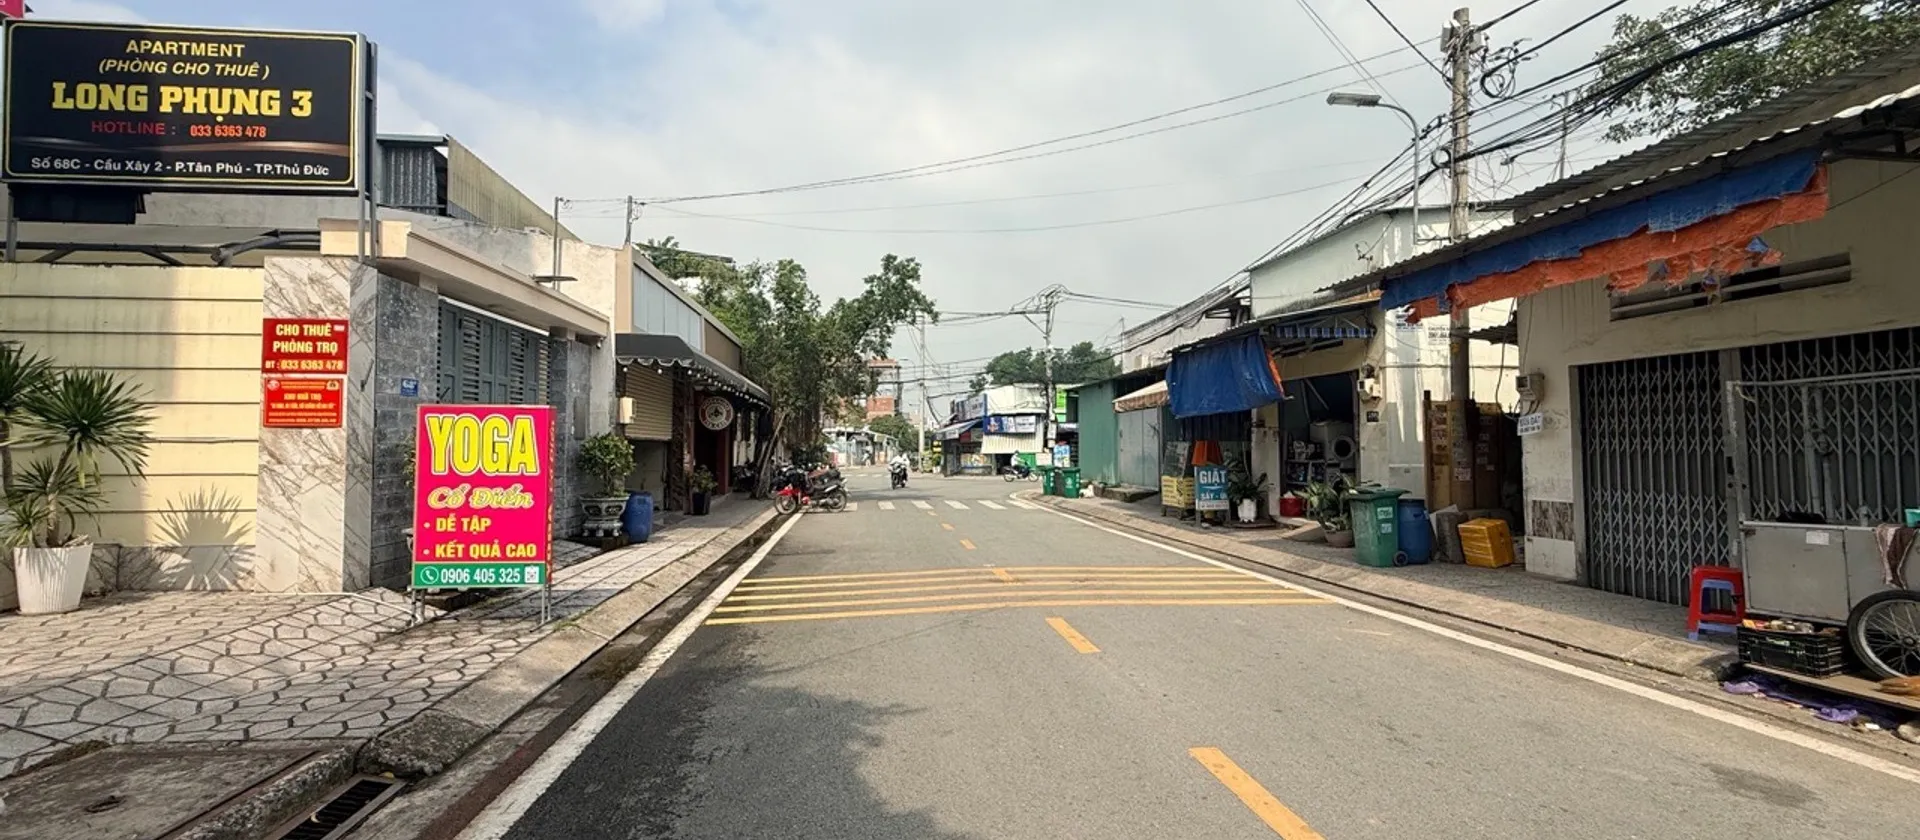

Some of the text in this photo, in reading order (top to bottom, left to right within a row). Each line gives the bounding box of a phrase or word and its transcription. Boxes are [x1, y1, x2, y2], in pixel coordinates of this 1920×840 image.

[126, 39, 244, 58] APARTMENT
[98, 57, 168, 74] (PHÒNG
[172, 61, 210, 76] CHO
[215, 61, 260, 77] THUÊ
[52, 82, 313, 122] LONG PHỤNG 3
[91, 121, 166, 135] HOTLINE
[190, 125, 212, 137] 033
[214, 125, 243, 138] 6363
[245, 126, 267, 138] 478
[31, 156, 51, 169] Số
[53, 158, 81, 169] 68C
[125, 160, 149, 173] Xây
[154, 162, 163, 171] 2
[175, 162, 212, 173] P.Tân
[216, 162, 243, 174] Phú
[254, 163, 300, 175] TP.Thủ
[303, 164, 330, 176] Đức
[276, 323, 331, 337] CHO THUÊ
[272, 338, 338, 356] PHÒNG TRỌ
[280, 360, 298, 369] 033
[301, 360, 323, 370] 6363
[326, 361, 344, 370] 478
[426, 415, 540, 475] YOGA
[1199, 468, 1226, 487] GIẶT
[436, 513, 492, 535] DỄ TẬP
[435, 539, 537, 559] KẾT QUẢ CAO
[441, 568, 520, 583] 0906 405 325
